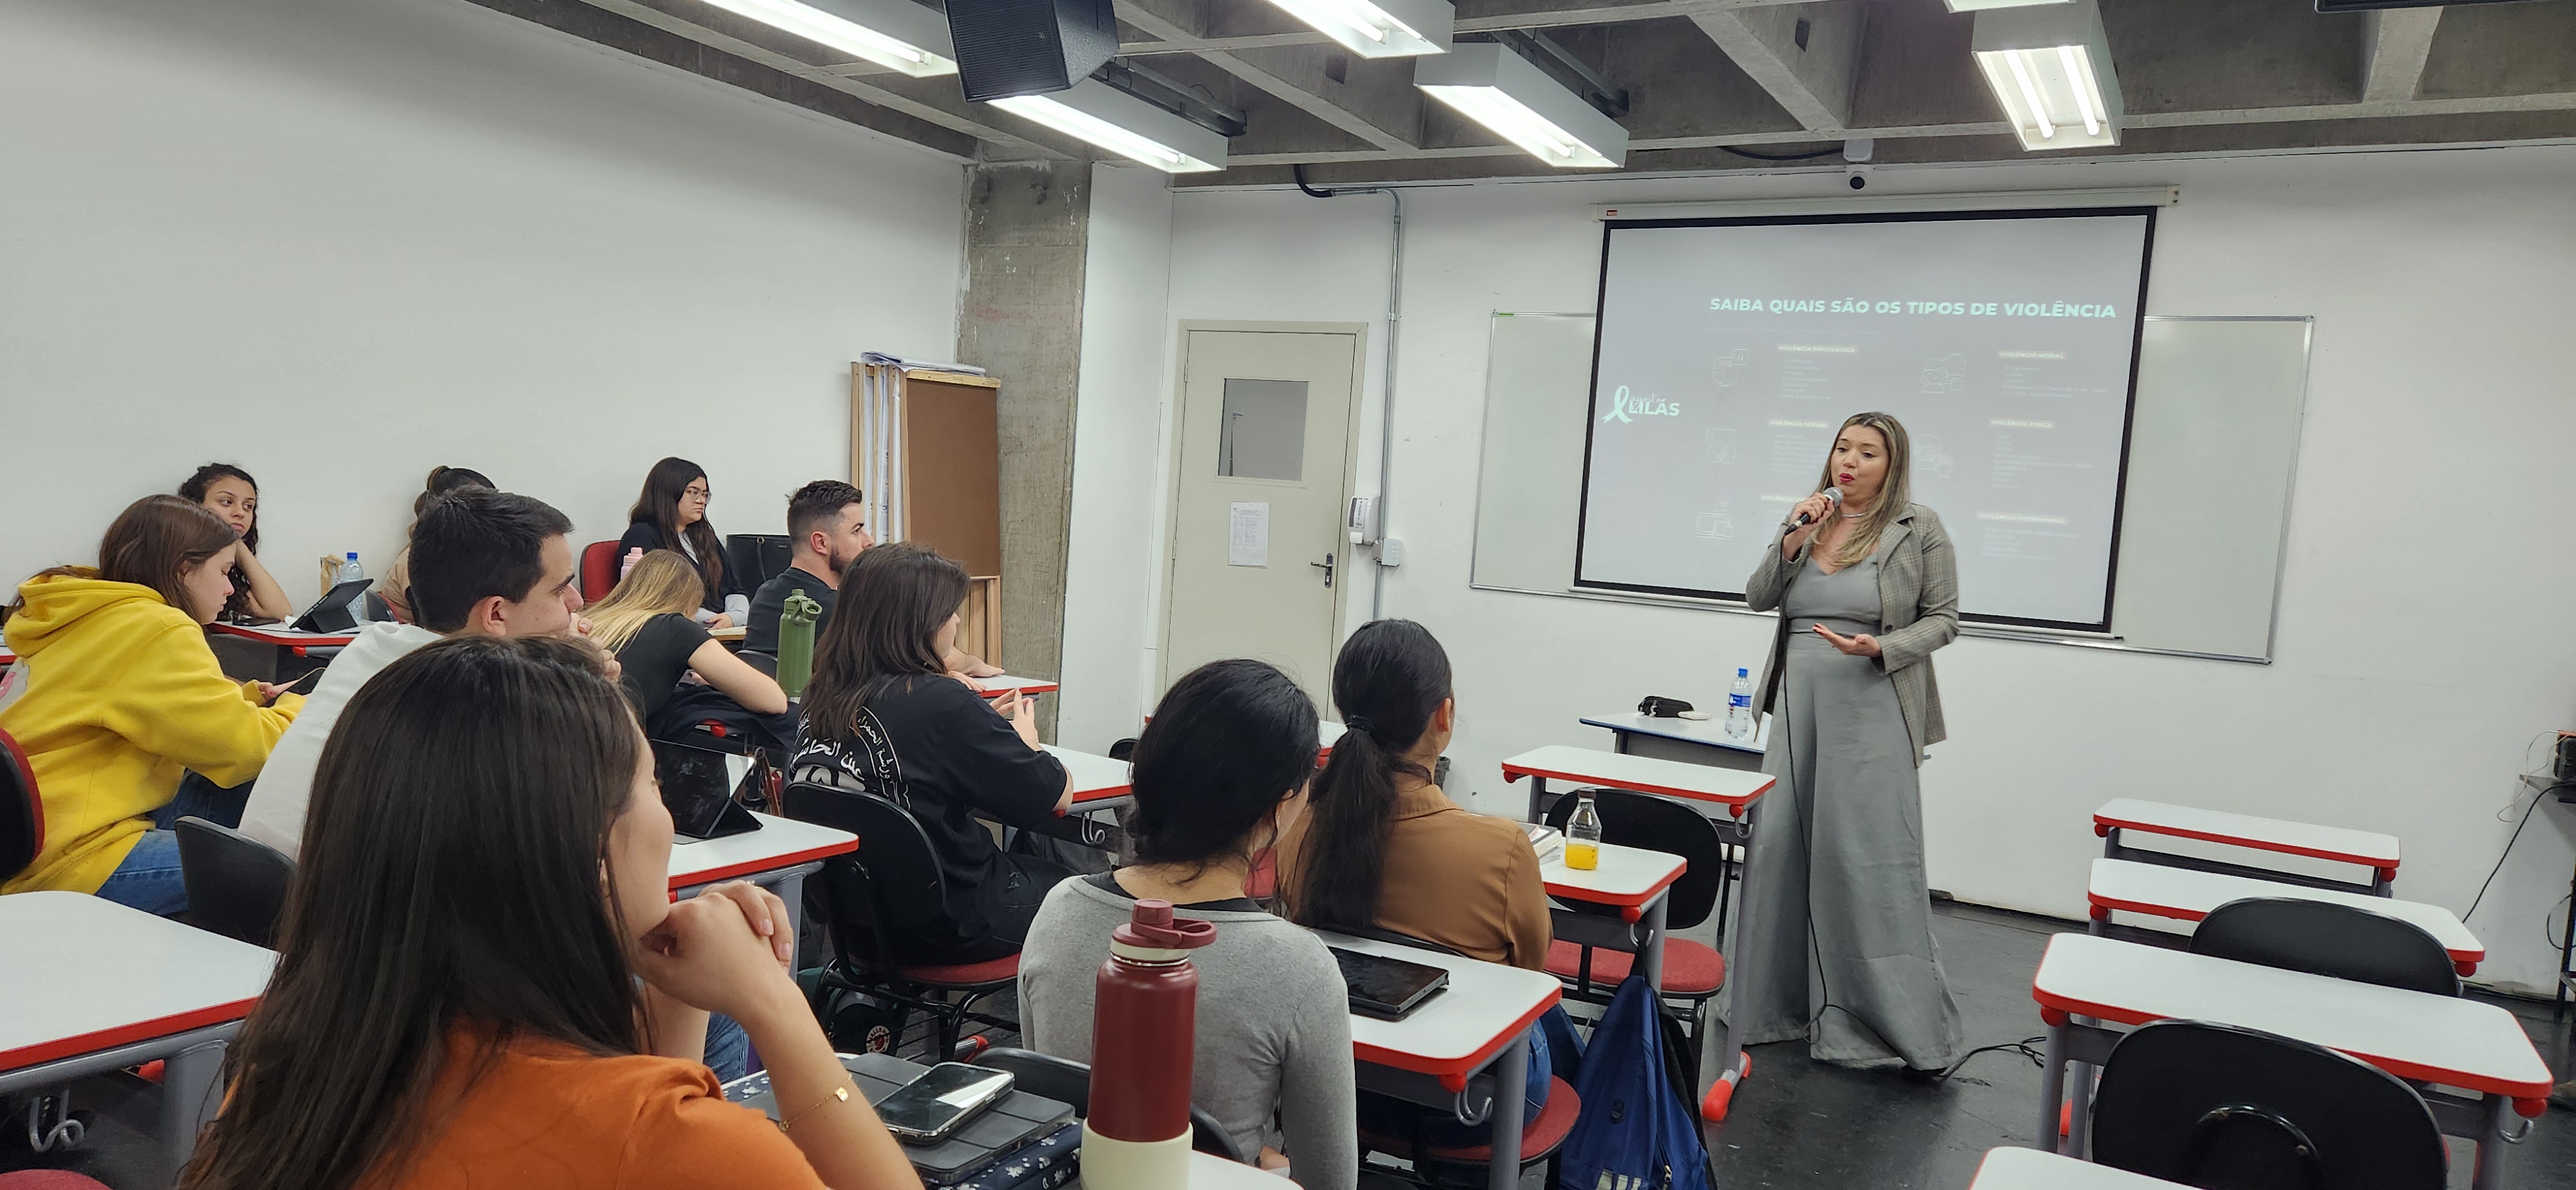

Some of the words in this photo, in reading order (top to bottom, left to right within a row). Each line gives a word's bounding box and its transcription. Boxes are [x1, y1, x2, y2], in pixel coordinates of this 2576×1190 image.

[1710, 298, 1764, 311] SAIBA
[1769, 299, 1825, 314] QUAIS
[1830, 297, 1870, 314] SÃO
[1875, 301, 1901, 314] OS
[1907, 301, 1965, 315] TIPOS
[1970, 303, 1998, 316] DE
[2003, 300, 2116, 317] VIOLÊNCIA
